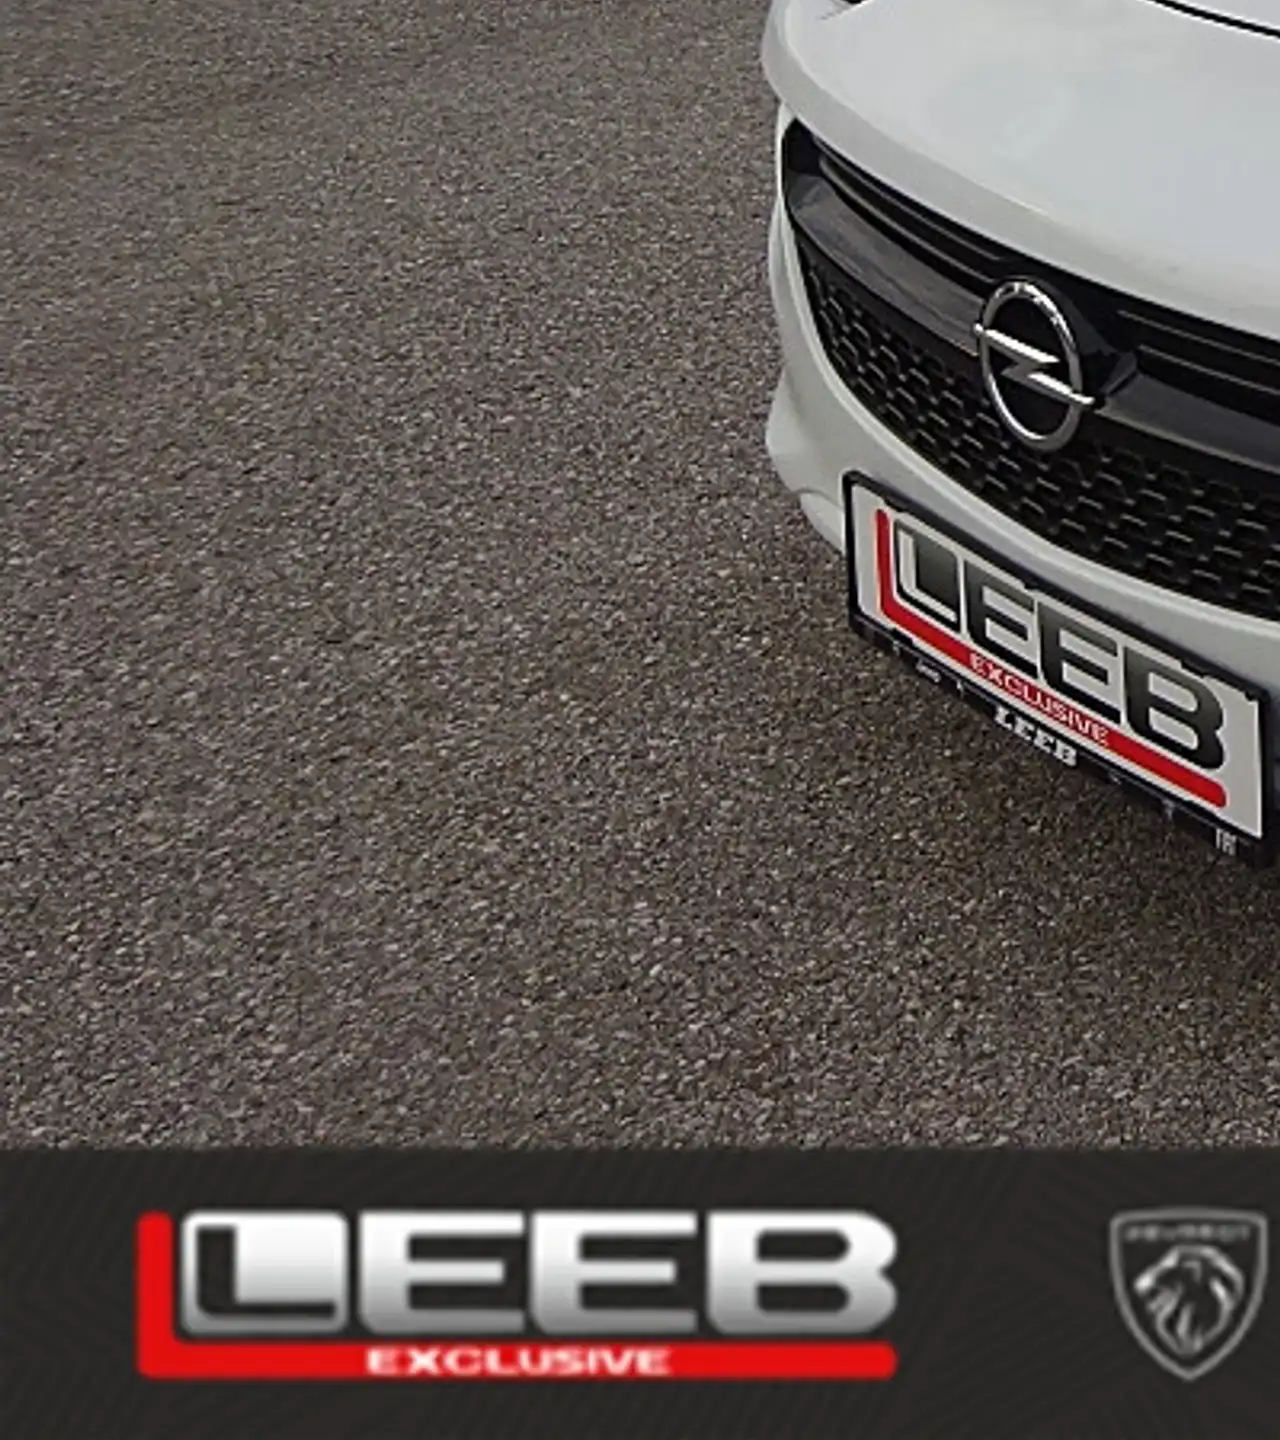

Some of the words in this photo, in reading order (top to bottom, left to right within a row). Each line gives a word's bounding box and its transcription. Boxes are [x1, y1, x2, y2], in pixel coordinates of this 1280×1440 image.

[893, 520, 1226, 771] LEEB
[968, 652, 1111, 747] EXCLUSIVE
[994, 706, 1077, 767] LEEB
